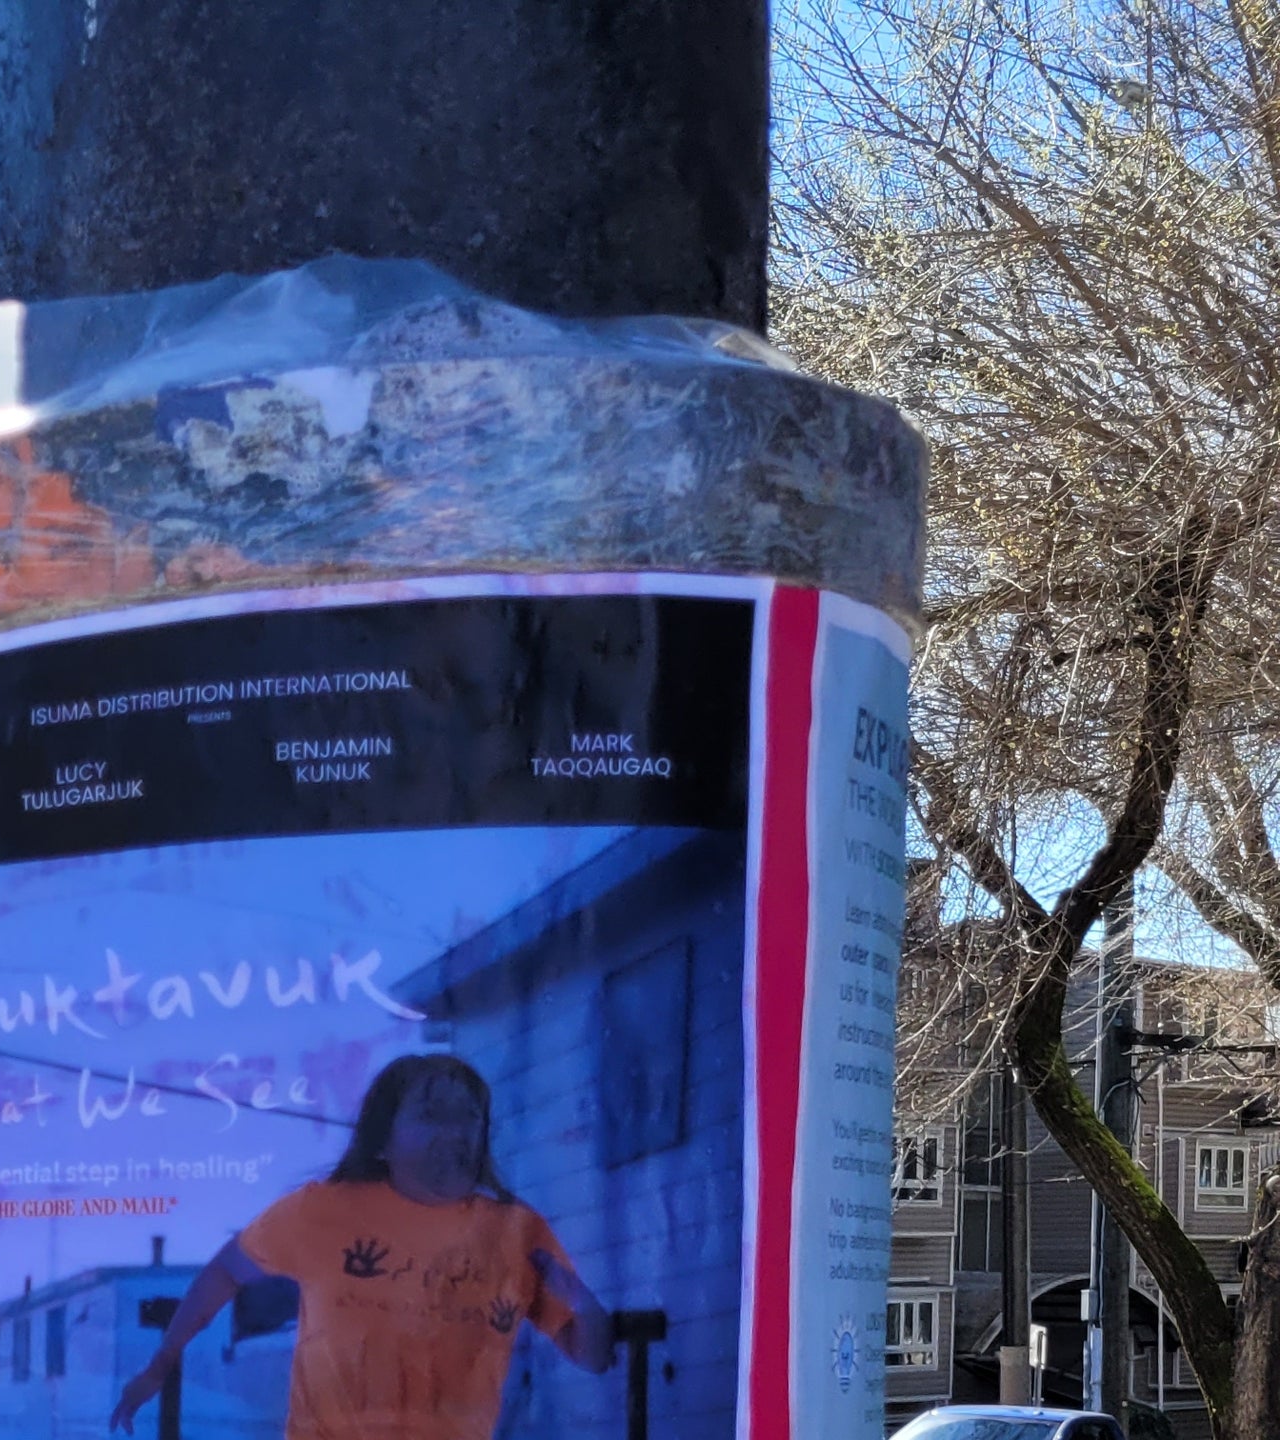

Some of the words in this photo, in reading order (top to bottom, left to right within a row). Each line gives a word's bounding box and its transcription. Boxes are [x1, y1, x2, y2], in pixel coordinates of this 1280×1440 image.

[31, 701, 92, 726] ISUMA
[98, 682, 235, 718] DISTRIBUTION
[240, 669, 413, 699] INTERNATIONAL
[187, 711, 232, 725] PRESENTS
[276, 737, 392, 761] BENJAMIN
[570, 734, 633, 754] MARK
[55, 761, 107, 785] LUCY
[296, 762, 372, 784] KUNUK
[531, 756, 672, 778] TAQQAUGAQ
[22, 779, 144, 811] TULUGARJUK
[78, 1065, 168, 1130] We
[194, 1052, 319, 1133] See
[65, 1158, 119, 1187] step
[127, 1157, 150, 1182] in
[22, 1199, 76, 1218] GLOBE
[80, 1197, 117, 1216] AND
